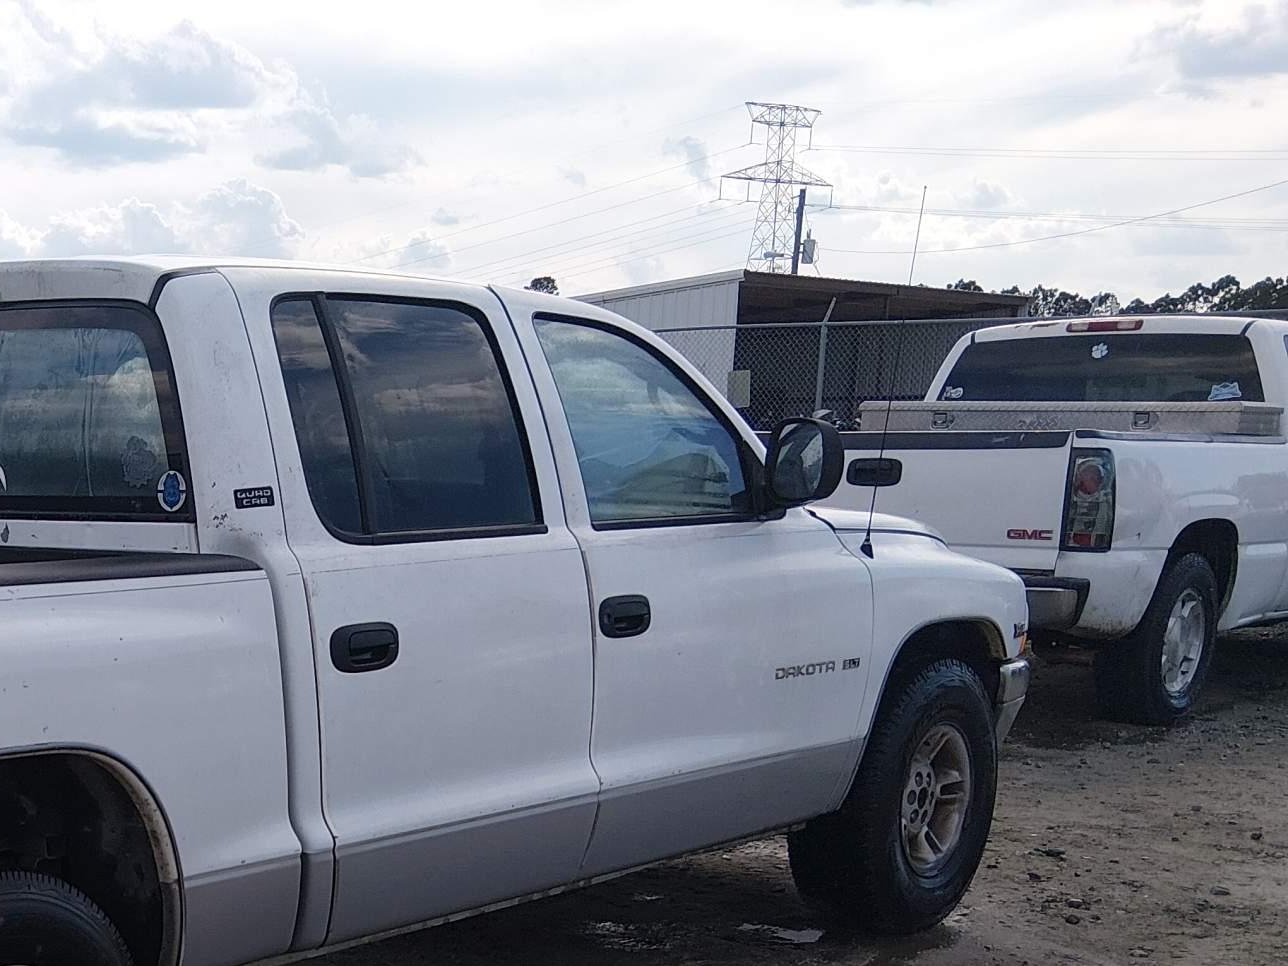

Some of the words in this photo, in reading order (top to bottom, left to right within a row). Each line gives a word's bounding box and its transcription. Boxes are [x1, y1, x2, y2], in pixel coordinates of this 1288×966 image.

[236, 489, 272, 498] QUAD
[242, 497, 269, 506] CAB
[1007, 529, 1053, 540] GMC
[775, 660, 836, 680] DAKOTA
